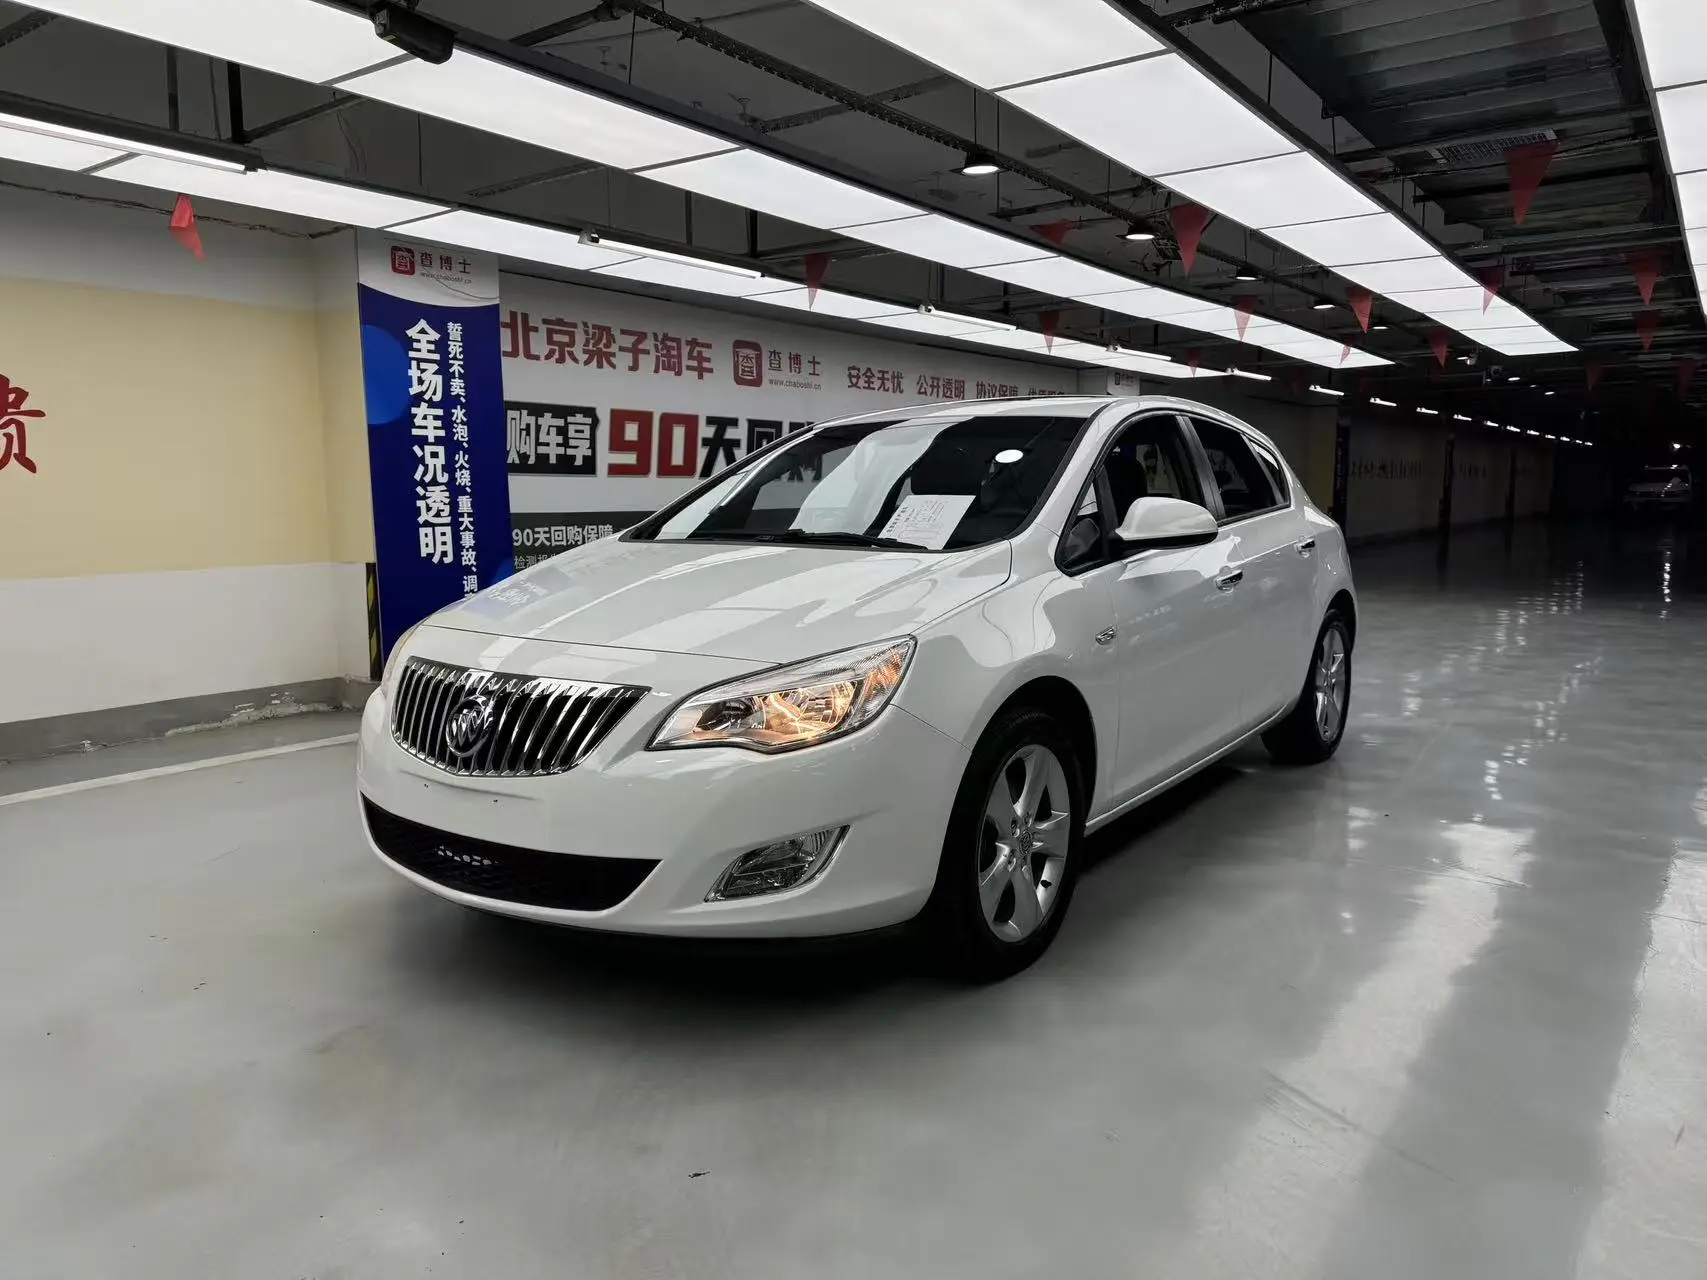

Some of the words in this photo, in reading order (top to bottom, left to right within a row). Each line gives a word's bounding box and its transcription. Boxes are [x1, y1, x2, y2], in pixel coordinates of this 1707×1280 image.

[420, 252, 471, 274] 查博士
[501, 310, 714, 380] 北京梁子淘车
[768, 349, 821, 376] 查博士
[768, 378, 822, 390] www.chaboshi.cn
[847, 365, 904, 394] 安全无忧
[916, 374, 965, 400] 公开透明
[405, 318, 454, 564] 全场车况透明
[506, 409, 592, 466] 购车享
[512, 524, 613, 547] 90天回购保障
[514, 553, 557, 570] 检测
